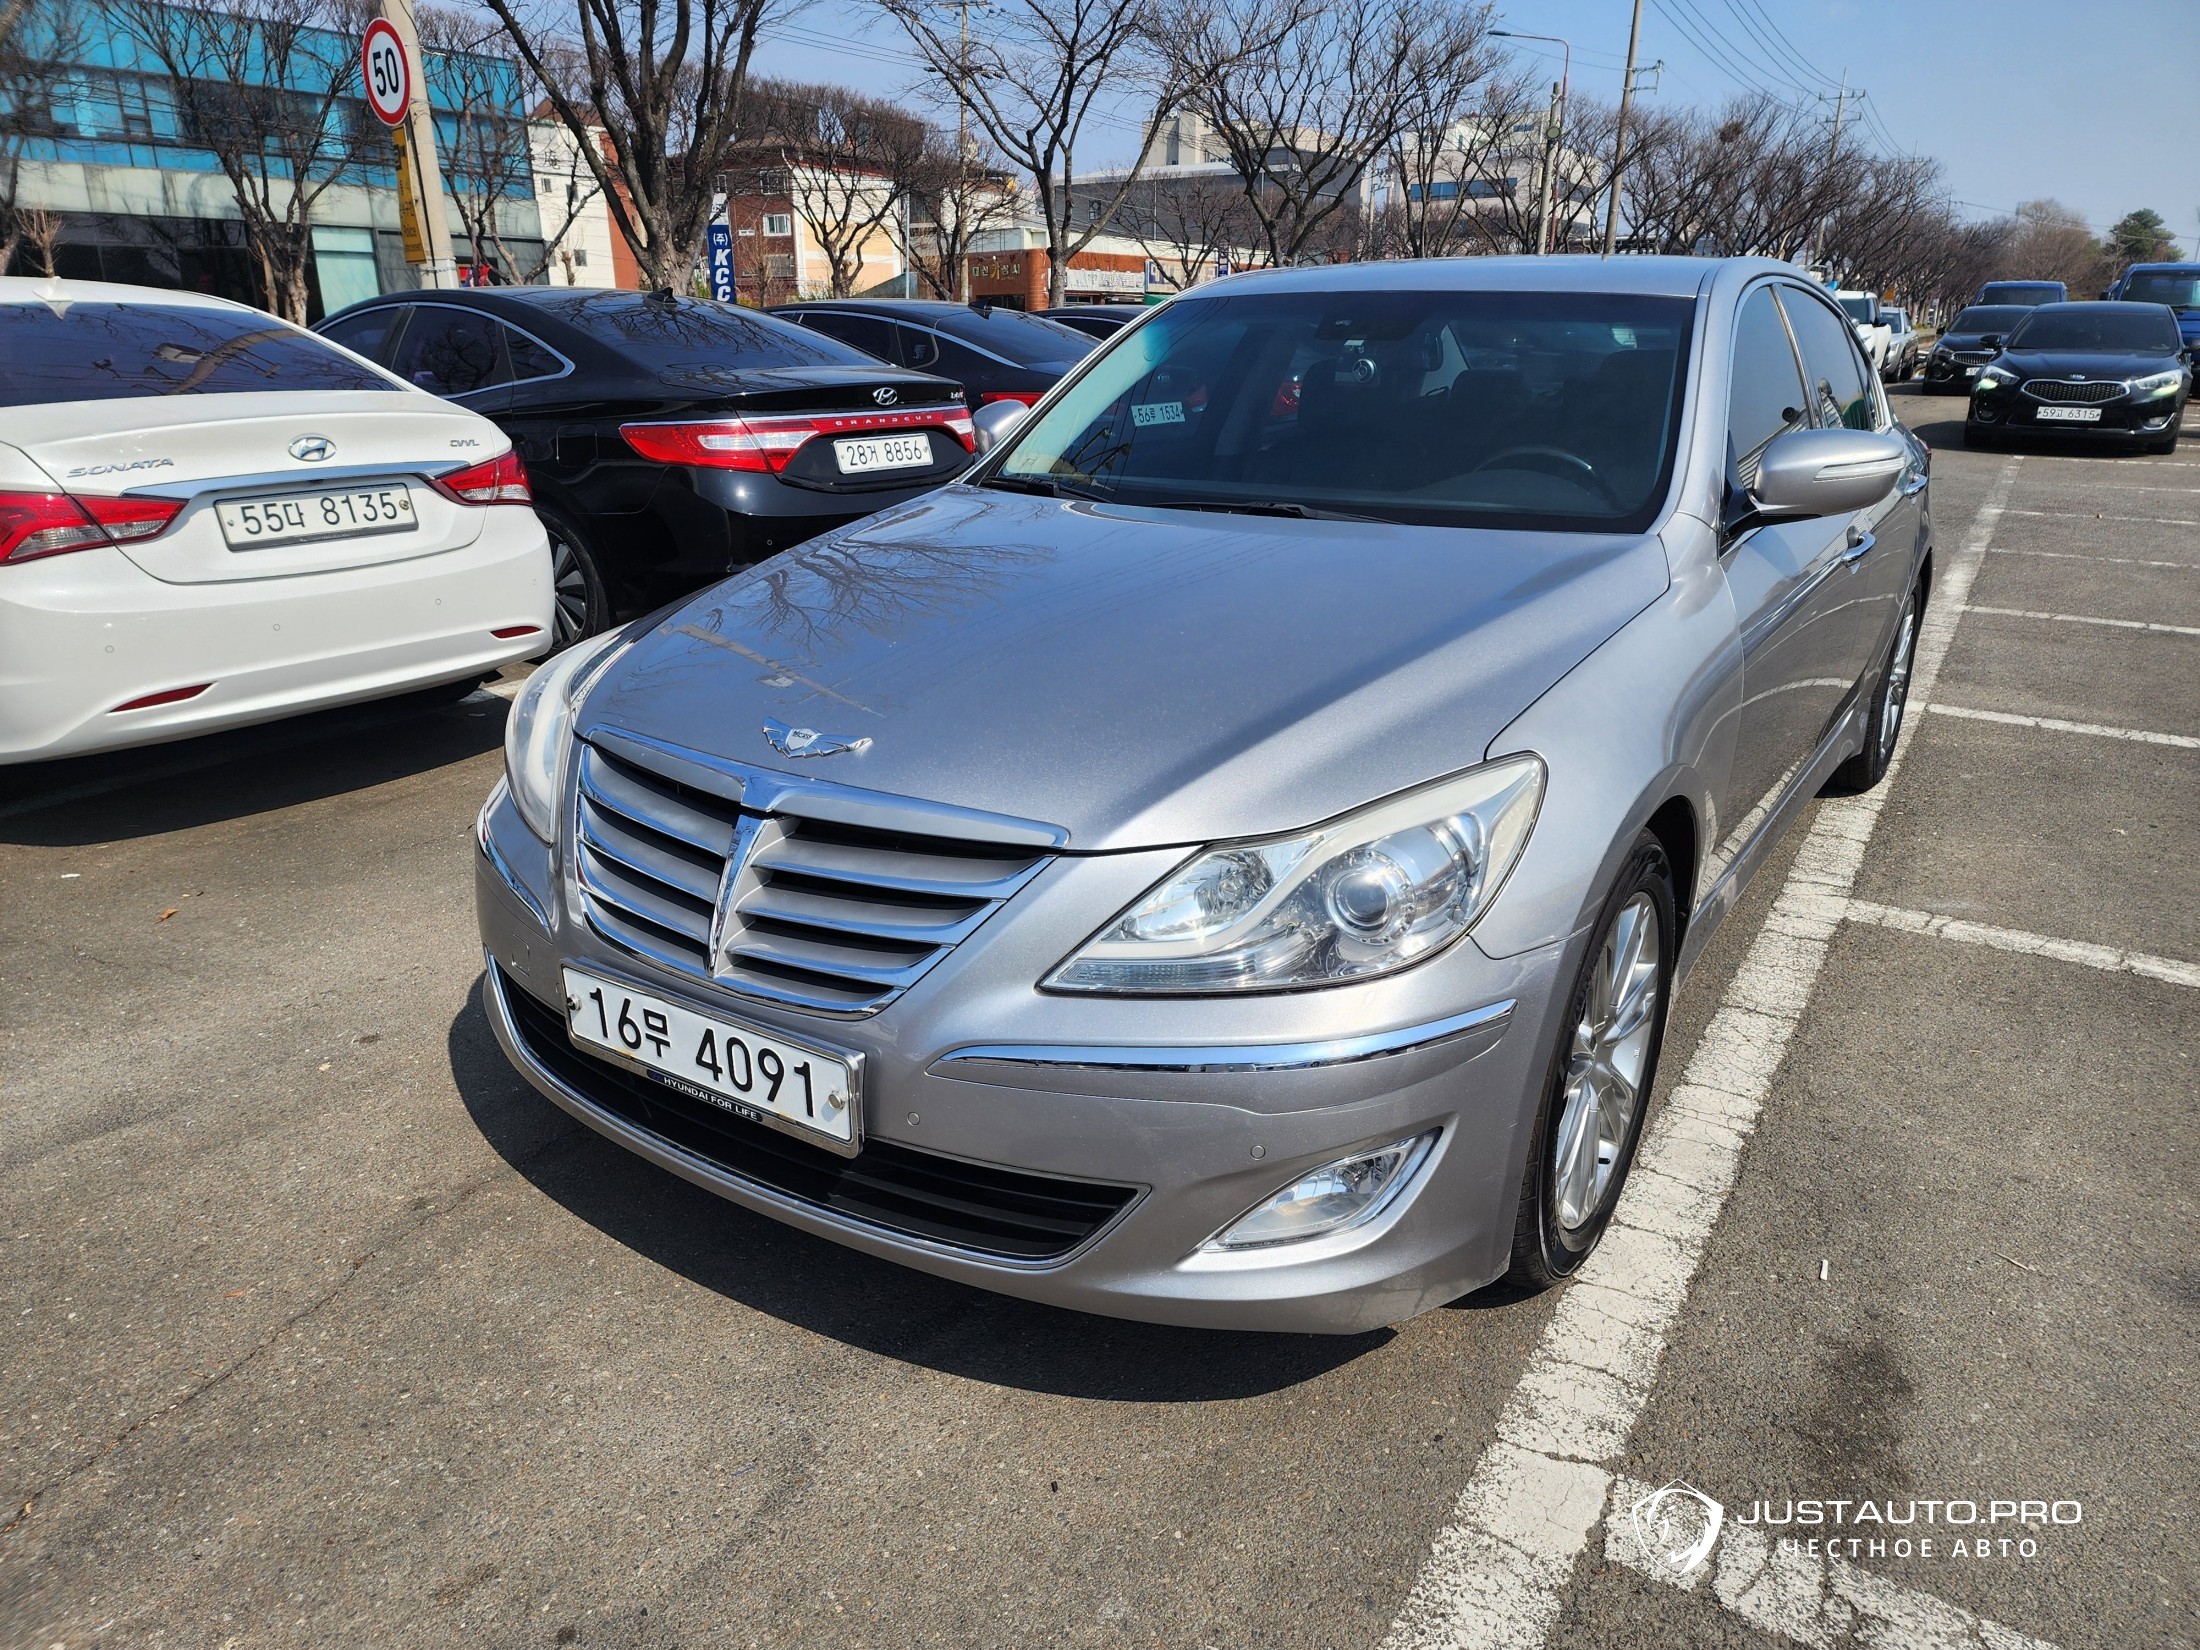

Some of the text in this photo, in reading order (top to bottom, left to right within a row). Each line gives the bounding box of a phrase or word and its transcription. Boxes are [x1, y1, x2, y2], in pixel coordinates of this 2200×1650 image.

[373, 47, 399, 97] 50
[713, 232, 728, 246] (주)
[714, 248, 732, 302] KCC
[835, 415, 932, 426] GRANDEUR
[1160, 404, 1181, 420] 1534
[2067, 409, 2096, 419] 6315
[884, 440, 922, 462] 8856
[67, 458, 174, 478] SONATA
[240, 492, 398, 535] 55다 8135
[589, 986, 815, 1118] 16무 4091
[663, 1076, 758, 1120] HYUNDAI FOR LIFE
